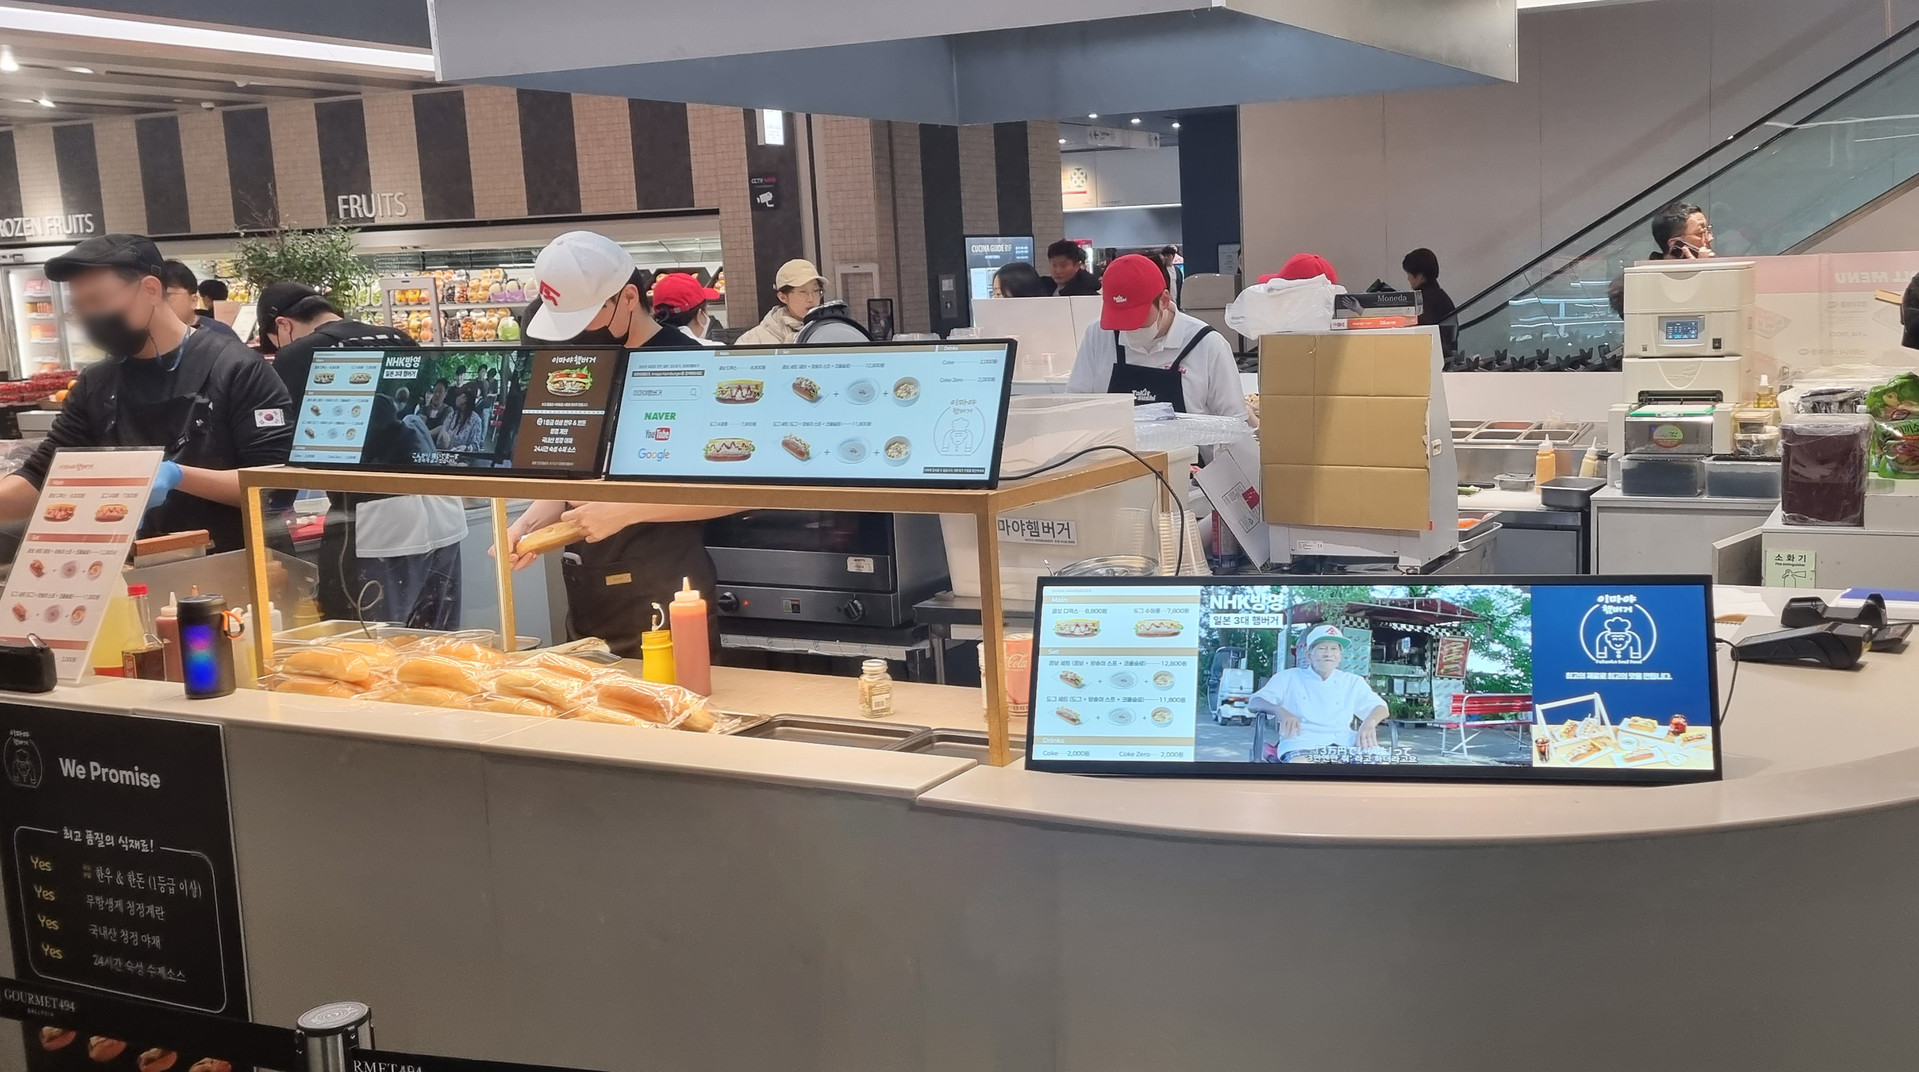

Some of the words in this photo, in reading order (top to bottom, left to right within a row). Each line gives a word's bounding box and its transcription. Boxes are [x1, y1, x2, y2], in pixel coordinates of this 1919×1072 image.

[337, 192, 408, 219] FRUITS
[46, 213, 95, 236] FRUITS
[1377, 294, 1408, 302] Moneda
[386, 356, 421, 368] NHK방영
[644, 412, 676, 421] NAVER
[645, 427, 671, 441] YouTube
[638, 448, 670, 462] Google
[1210, 594, 1284, 612] NHK방영
[1597, 594, 1637, 604] 이마야
[1602, 605, 1633, 614] 햄버거
[1213, 615, 1231, 626] 일본
[1234, 615, 1249, 626] 3대
[1252, 615, 1279, 626] 햄버거
[59, 757, 86, 780] We
[90, 761, 161, 789] Promise
[62, 826, 82, 842] 최고
[85, 829, 115, 848] 품질의
[30, 855, 52, 871] Yes
[95, 866, 113, 885] 한우
[116, 871, 124, 886] &
[126, 870, 145, 890] 한돈
[34, 884, 56, 901] Yes
[37, 913, 60, 931] Yes
[88, 924, 117, 942] 국내산
[41, 942, 63, 960] Yes
[92, 954, 123, 972] 24시간
[4, 988, 58, 1009] GOURMET
[59, 998, 76, 1013] 494
